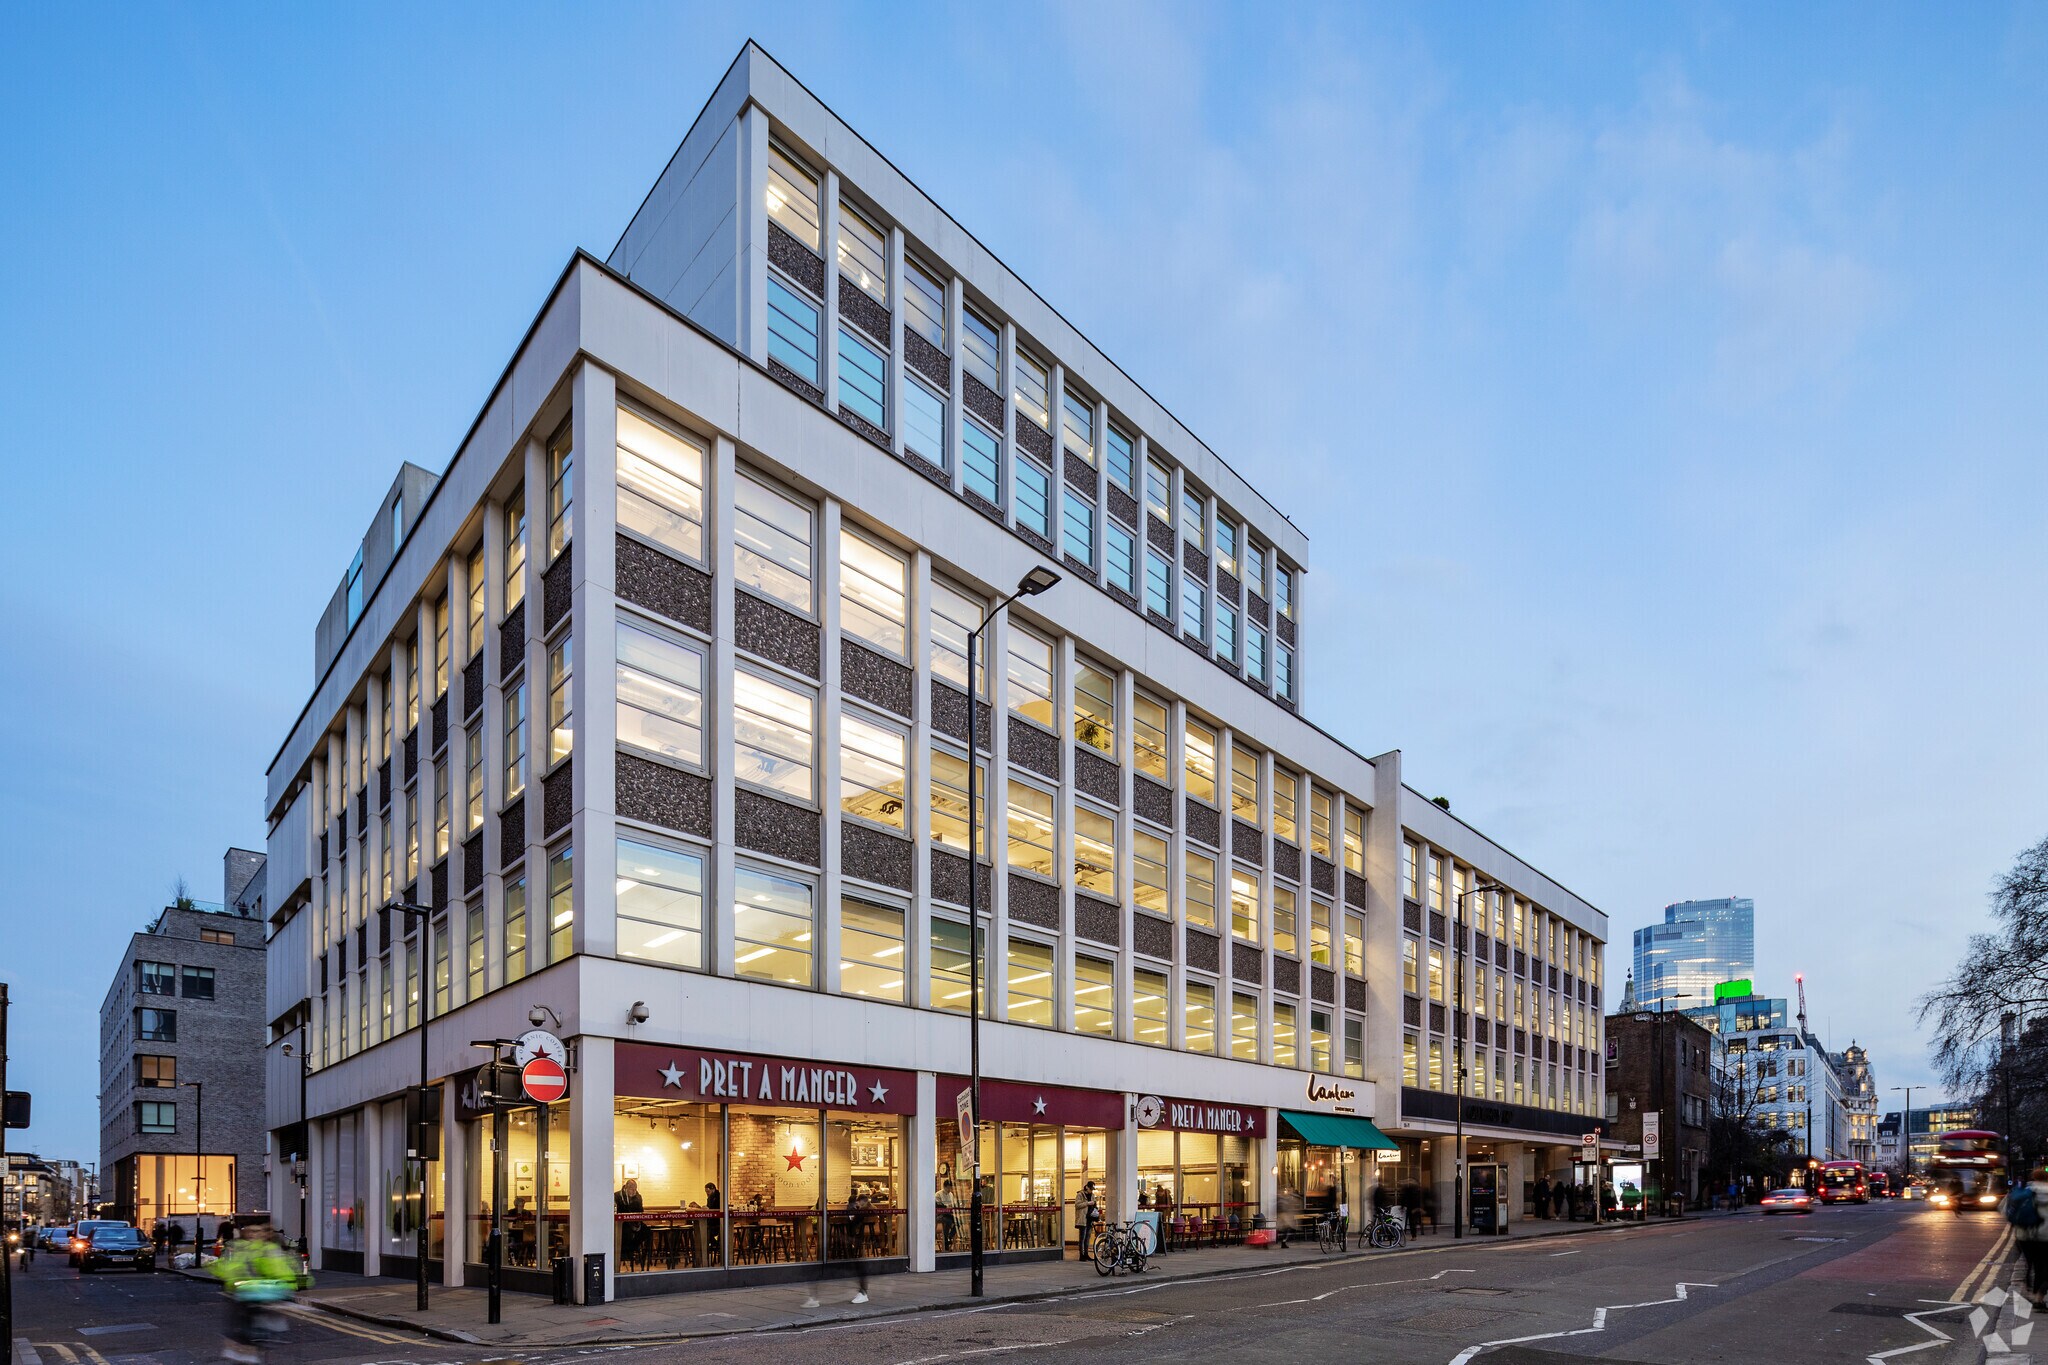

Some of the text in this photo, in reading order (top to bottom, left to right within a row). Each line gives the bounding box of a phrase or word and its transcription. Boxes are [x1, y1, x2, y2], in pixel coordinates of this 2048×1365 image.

[545, 1036, 563, 1057] COFFEE
[700, 1057, 858, 1106] PRET A MANGER
[1171, 1103, 1195, 1128] PRET
[1197, 1106, 1204, 1129] A
[1207, 1107, 1242, 1132] MANGER
